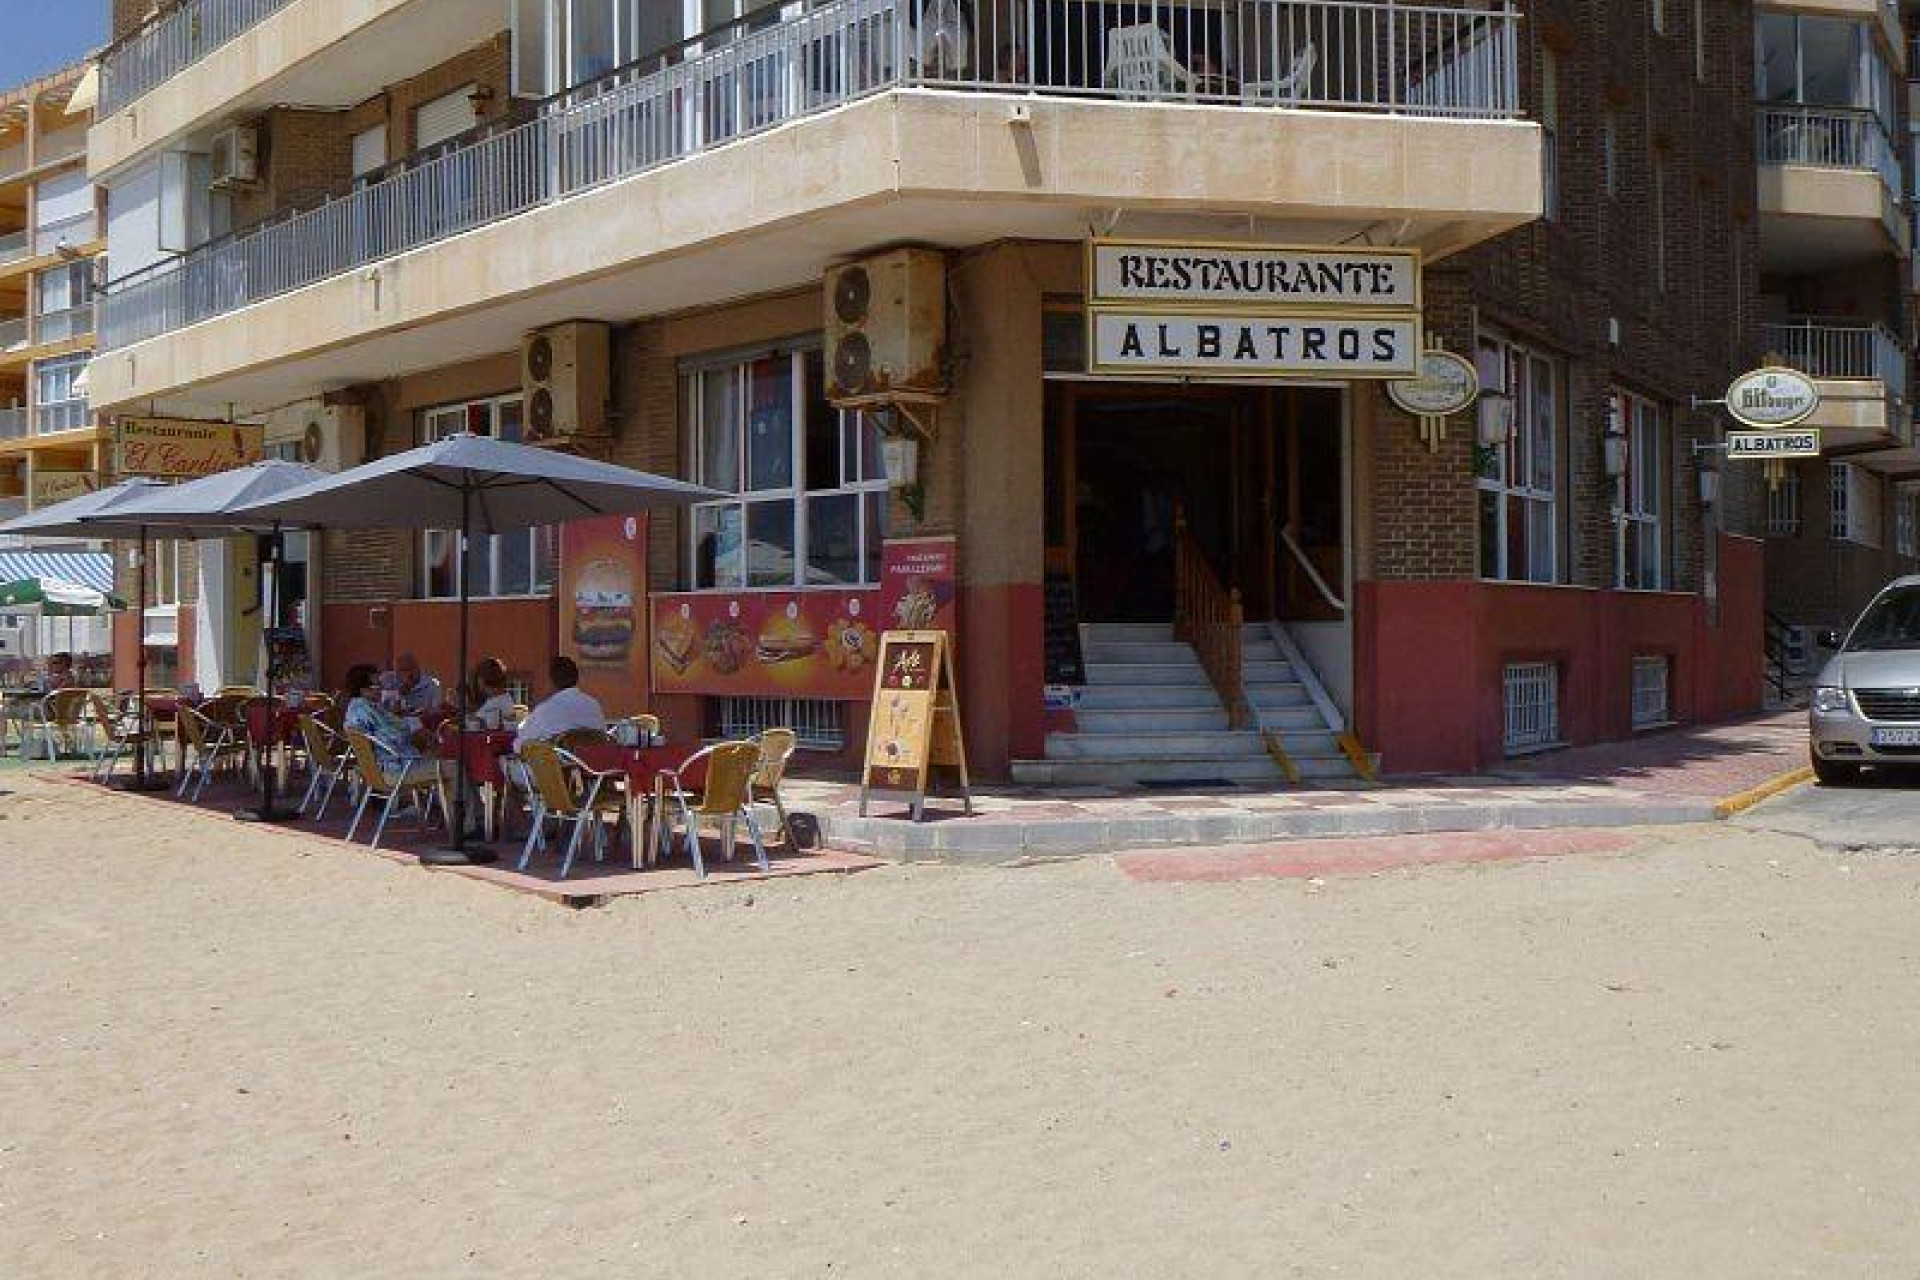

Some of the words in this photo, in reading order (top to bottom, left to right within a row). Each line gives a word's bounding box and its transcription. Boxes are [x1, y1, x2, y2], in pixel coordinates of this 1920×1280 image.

[1118, 255, 1396, 295] RESTAURANTE
[1120, 323, 1396, 362] ALBATROS
[1733, 436, 1813, 451] ALBATROS
